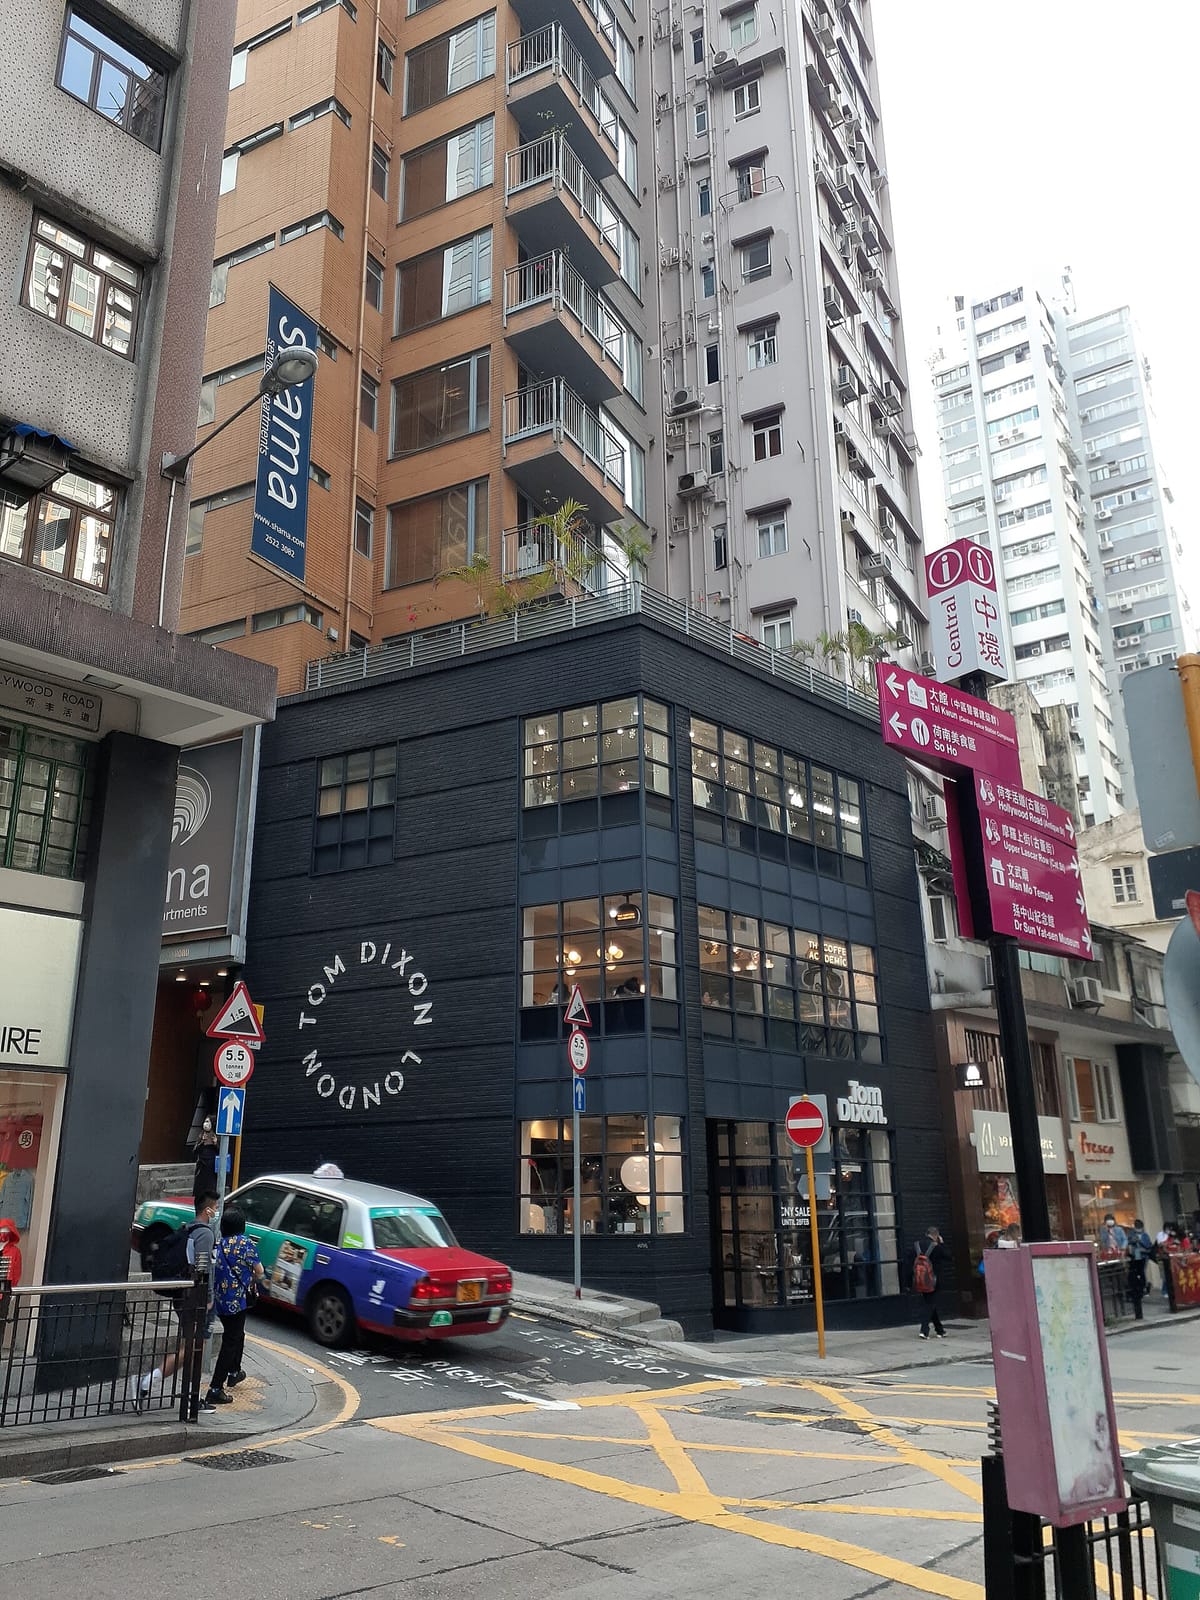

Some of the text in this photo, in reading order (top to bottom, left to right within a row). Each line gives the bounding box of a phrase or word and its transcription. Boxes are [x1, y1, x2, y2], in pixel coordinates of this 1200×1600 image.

[259, 393, 272, 457] partments
[267, 315, 307, 510] sama
[254, 511, 305, 549] www.shama.com
[265, 534, 280, 549] 2522
[941, 594, 962, 668] Central
[974, 594, 1004, 669] 中環
[0, 675, 95, 709] YWOOD ROAD
[930, 702, 940, 713] Tai
[941, 706, 958, 720] Kwun
[934, 740, 958, 756] So Ho
[998, 800, 1029, 821] Hollywood
[1029, 815, 1043, 827] Road
[1003, 840, 1020, 853] Upper
[1021, 846, 1038, 859] Lascar
[1038, 853, 1049, 865] Row
[1009, 879, 1054, 902] Man Mo Temple
[1014, 919, 1080, 949] Dr Sun Yat-sen Museum
[823, 943, 847, 956] COFFE
[298, 941, 433, 1030] TOM DIXON
[230, 1007, 246, 1022] 1:5
[225, 1049, 245, 1062] 5.5
[574, 1037, 585, 1050] 5.5
[302, 1049, 422, 1110] LONDON
[848, 1080, 883, 1105] Tom
[795, 1206, 811, 1217] SALE
[420, 1360, 529, 1393] RIGHT
